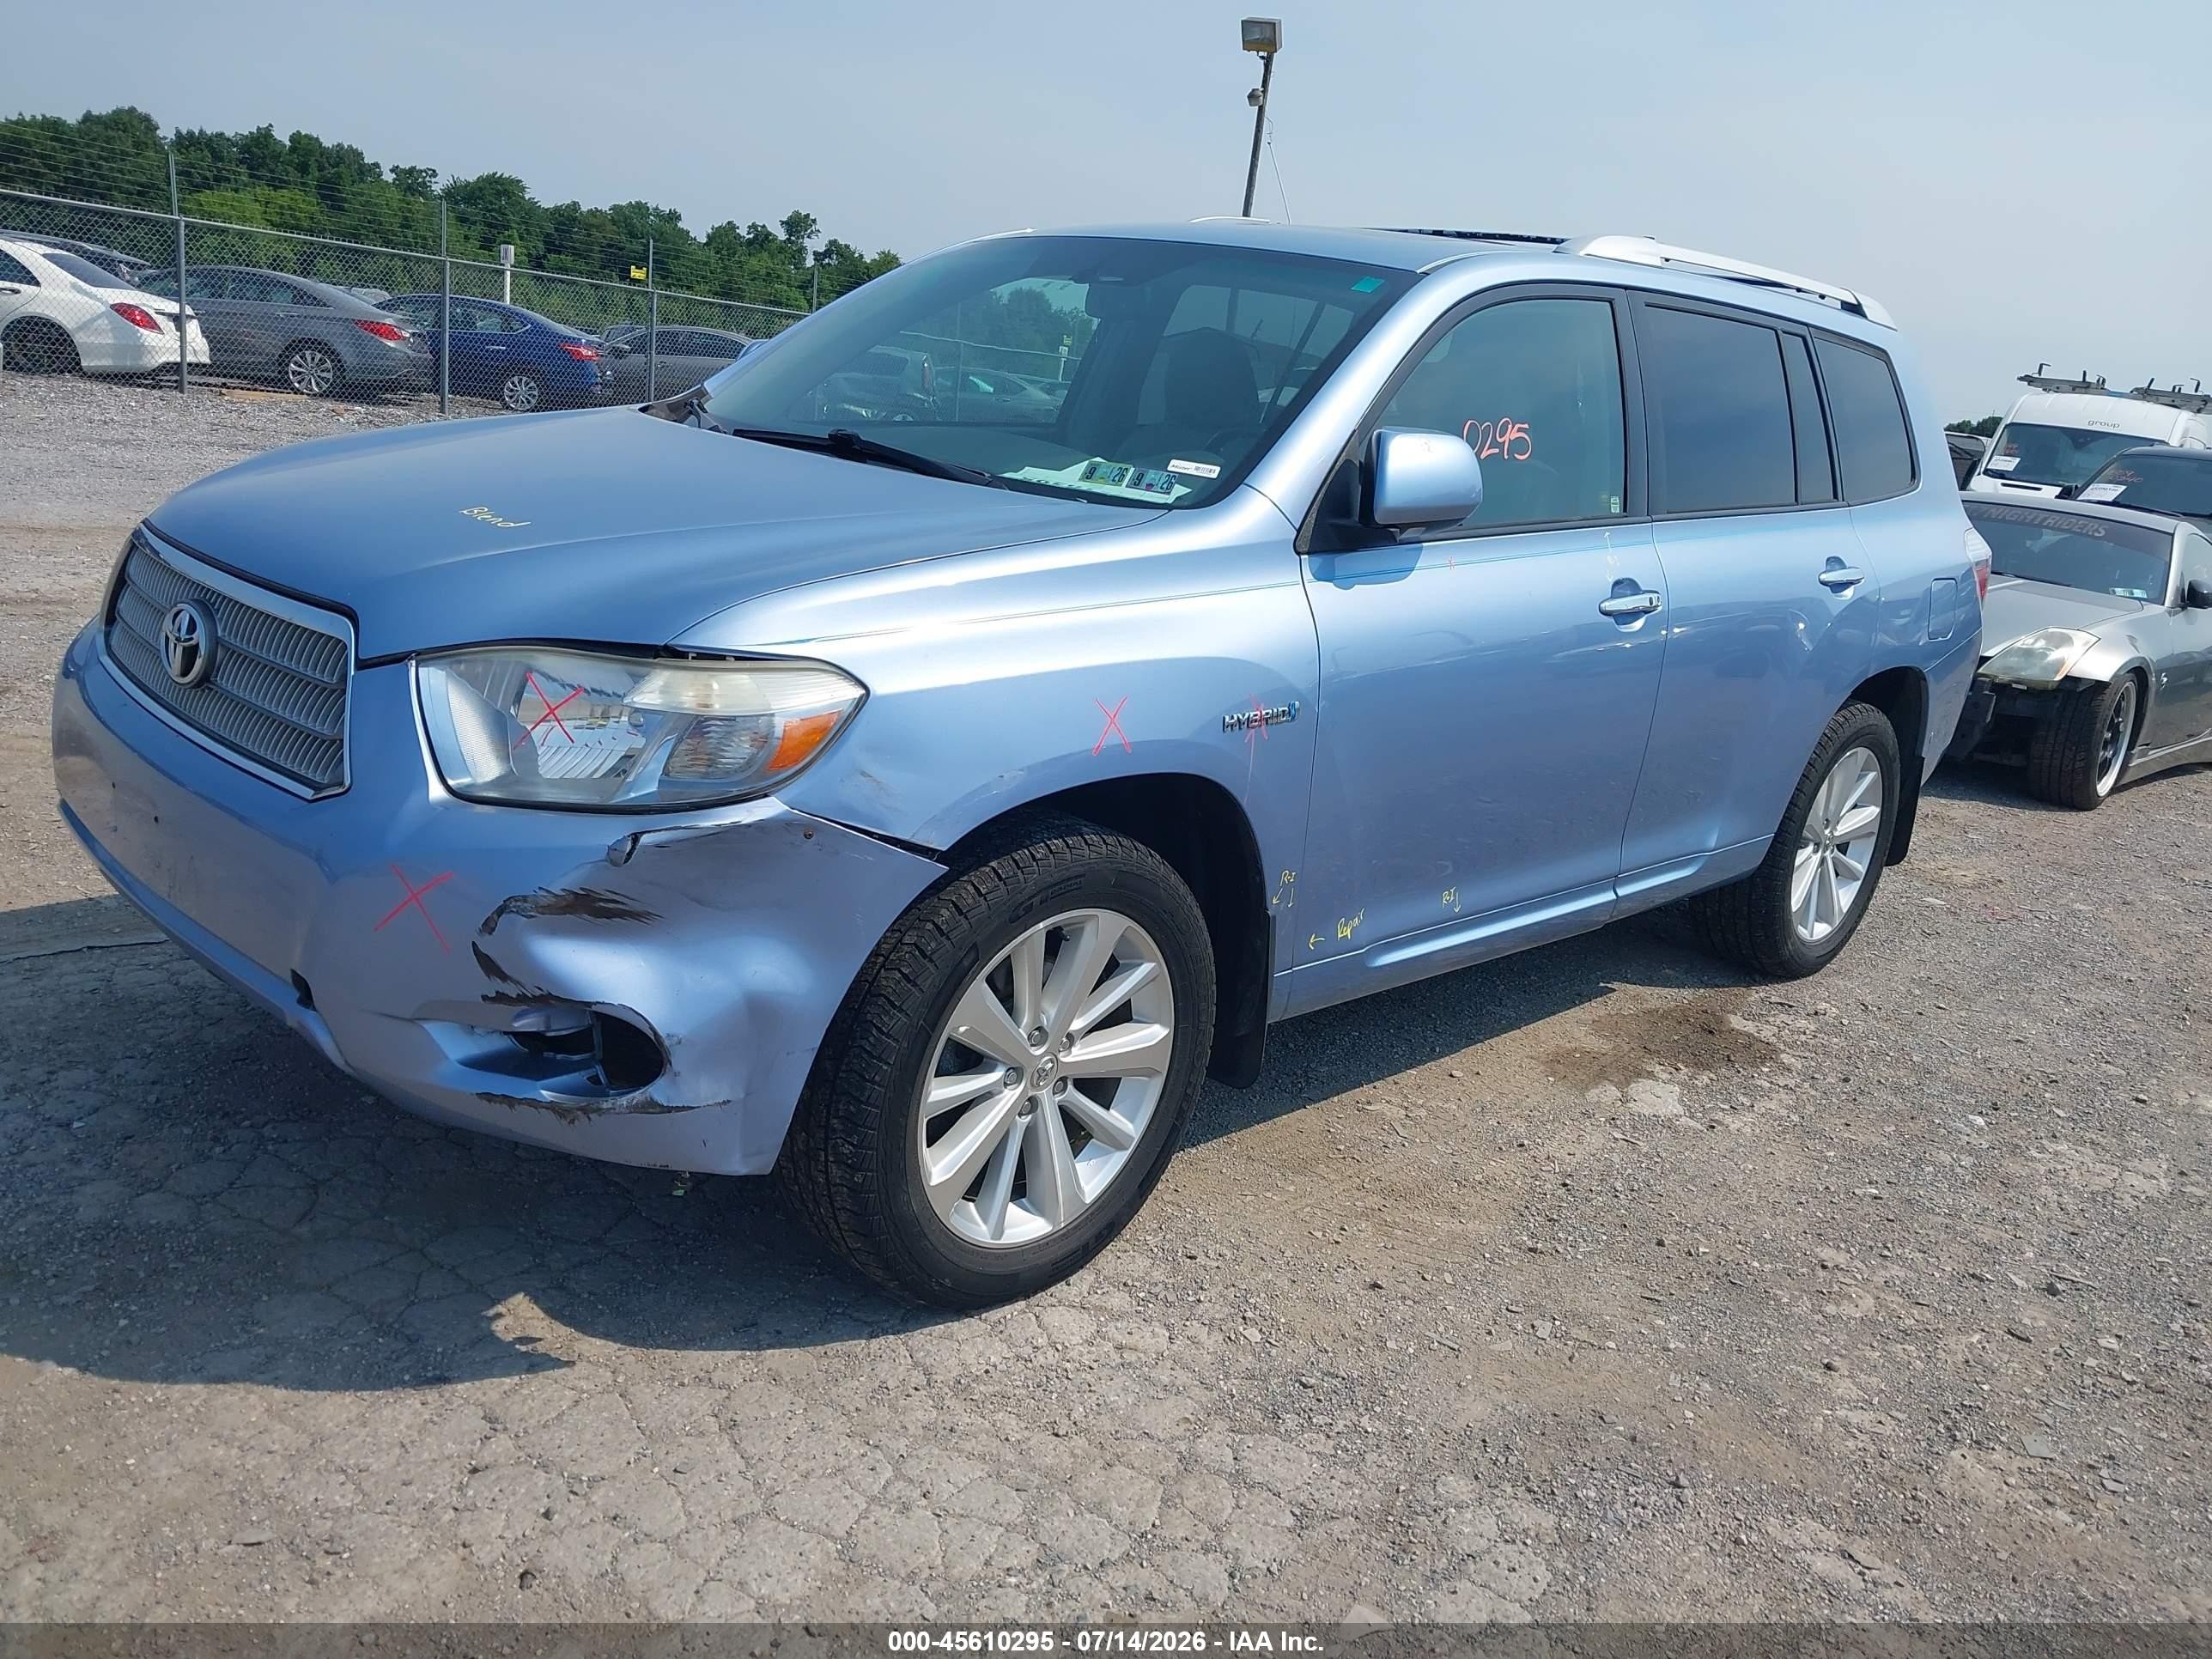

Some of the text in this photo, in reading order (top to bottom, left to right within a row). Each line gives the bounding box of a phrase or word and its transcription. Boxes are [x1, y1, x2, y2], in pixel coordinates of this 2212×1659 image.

[2087, 420, 2120, 429] group
[1462, 417, 1532, 460] 0295
[1111, 466, 1129, 483] 26
[1159, 473, 1177, 492] 26
[1222, 707, 1291, 732] HYBRID
[1337, 907, 1365, 941] Repair
